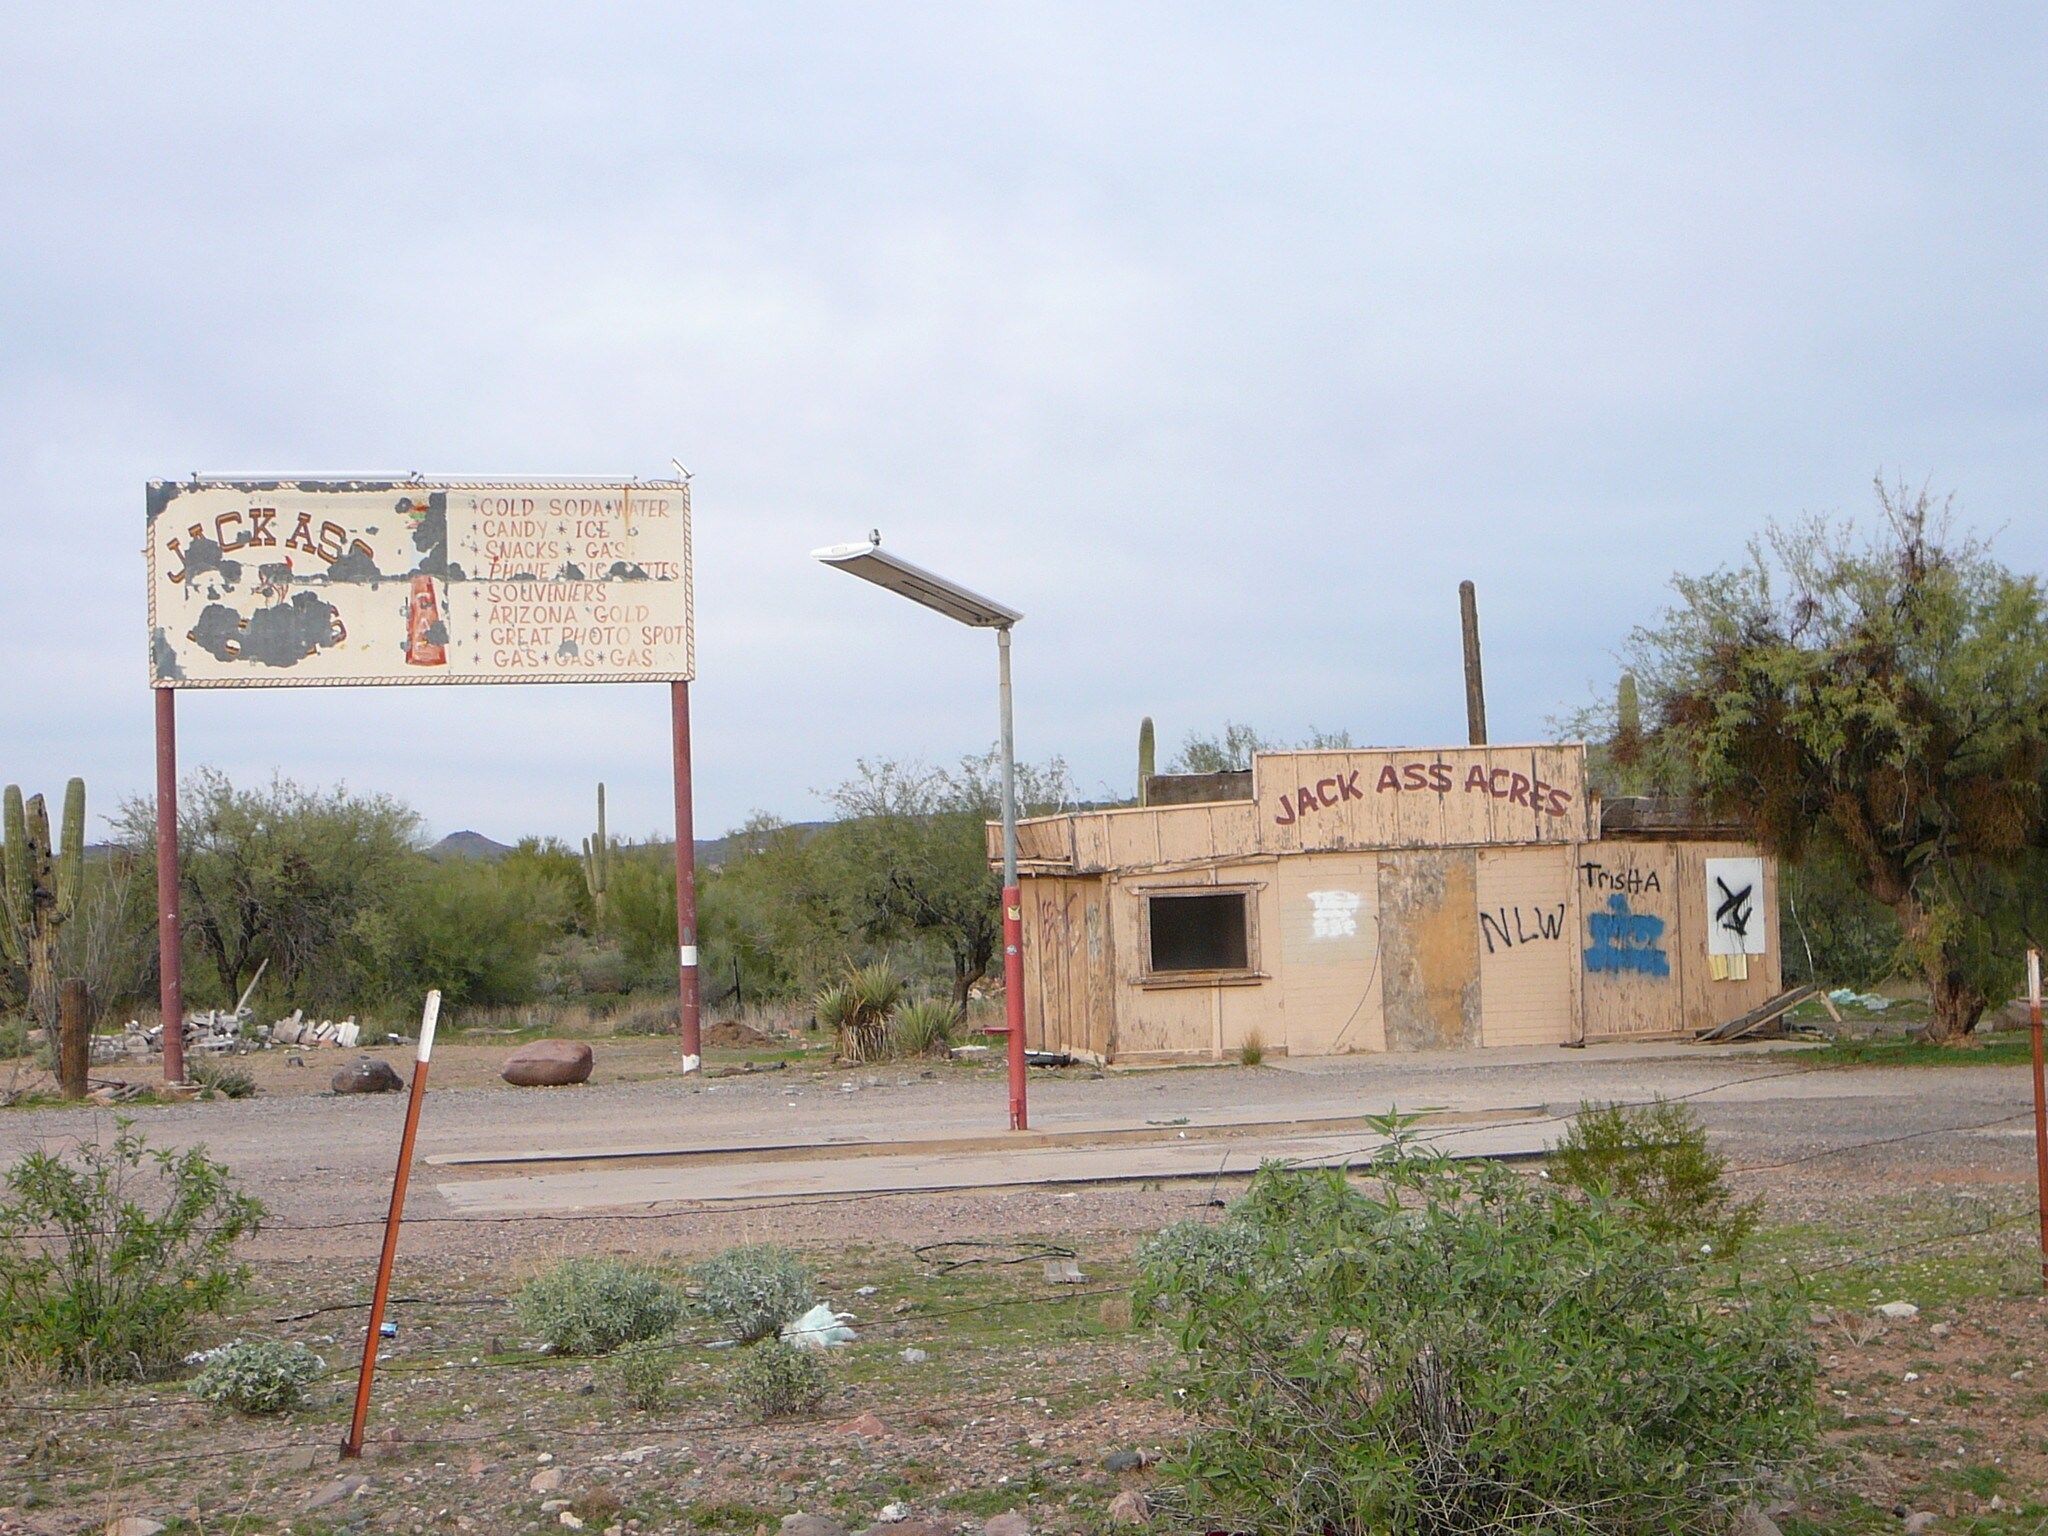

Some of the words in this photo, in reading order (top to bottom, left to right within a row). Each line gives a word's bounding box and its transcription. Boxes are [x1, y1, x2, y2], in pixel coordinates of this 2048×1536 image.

[480, 498, 534, 516] COLD
[549, 498, 605, 516] SODA
[614, 499, 670, 518] WATER
[483, 520, 547, 539] CANDY
[576, 520, 610, 539] ICE
[484, 541, 559, 559] SNACKS
[586, 541, 626, 559] GAS
[488, 583, 607, 603] SOUVENIERS
[488, 605, 578, 624] ARIZONA
[593, 605, 649, 623] GOLD
[490, 627, 553, 646] GREAT
[562, 626, 631, 645] PHOTO
[642, 625, 685, 645] SPOT
[494, 649, 539, 668] GAS
[610, 648, 653, 667] GAS
[1275, 770, 1364, 826] JACK
[1376, 763, 1454, 793] ASS
[1464, 764, 1573, 817] ACRES
[1480, 903, 1565, 953] NLW
